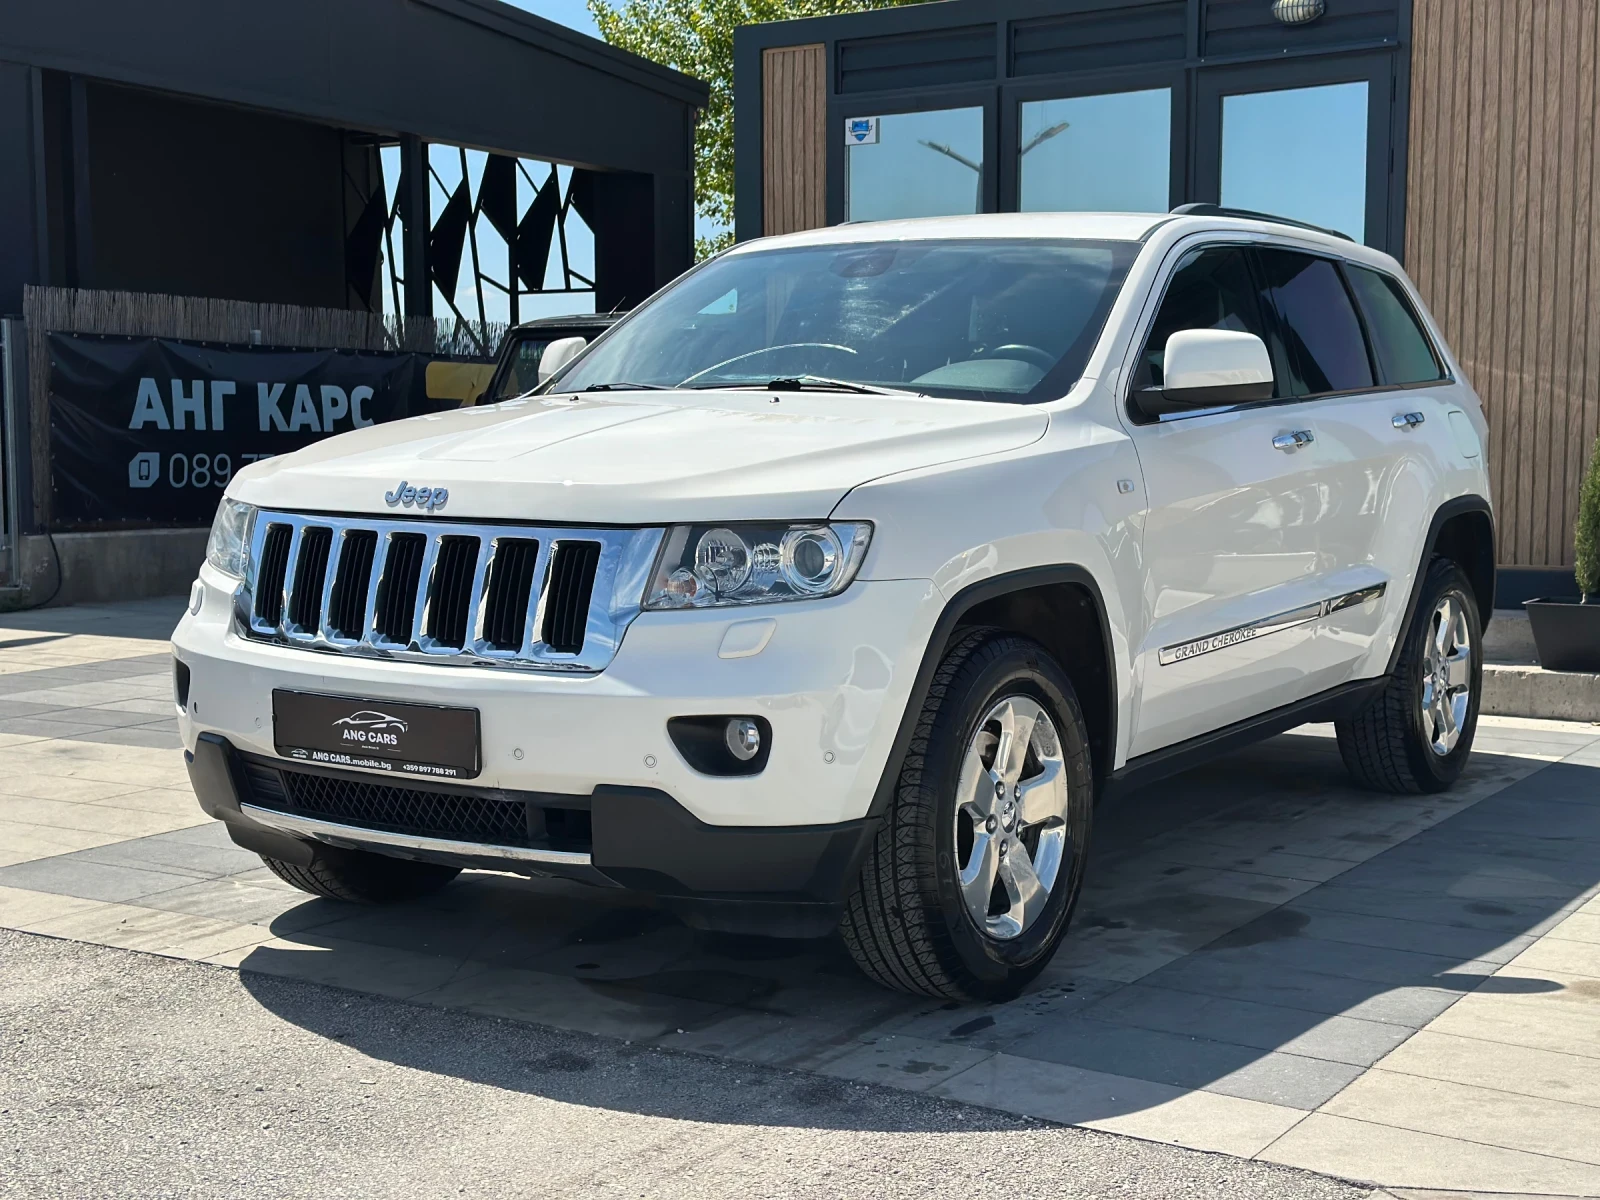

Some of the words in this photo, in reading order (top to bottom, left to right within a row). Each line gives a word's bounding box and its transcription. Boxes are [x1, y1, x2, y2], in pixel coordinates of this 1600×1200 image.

[128, 377, 237, 431] АНГ
[257, 382, 375, 432] КАРС
[169, 453, 232, 488] 089
[385, 480, 449, 511] Jeep
[1175, 640, 1209, 659] GRAND
[1212, 628, 1257, 649] CHEROKEE
[343, 729, 366, 741] ANG
[368, 732, 398, 745] CARS
[312, 751, 329, 761] ANG
[330, 754, 392, 770] CARS.mobile.bg
